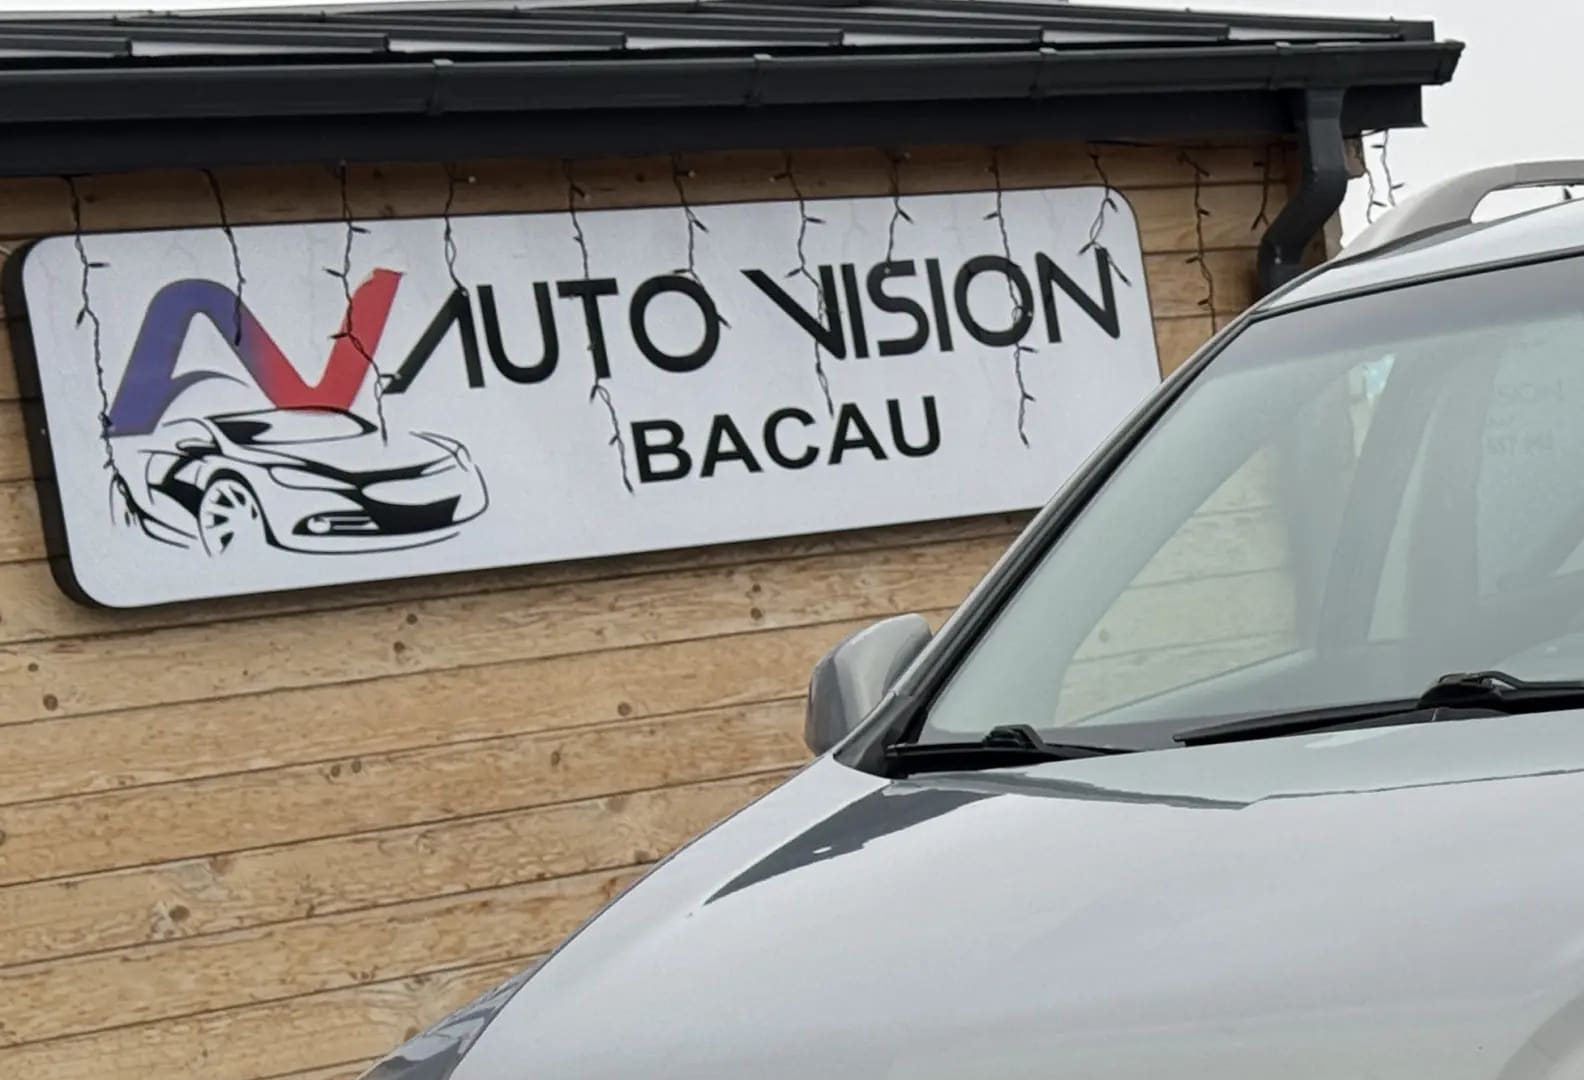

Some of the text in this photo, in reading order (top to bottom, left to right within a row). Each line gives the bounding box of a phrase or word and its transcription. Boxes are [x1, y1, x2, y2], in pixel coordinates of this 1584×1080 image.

[381, 247, 1121, 394] AUTO VISION
[630, 395, 941, 483] BACAU
